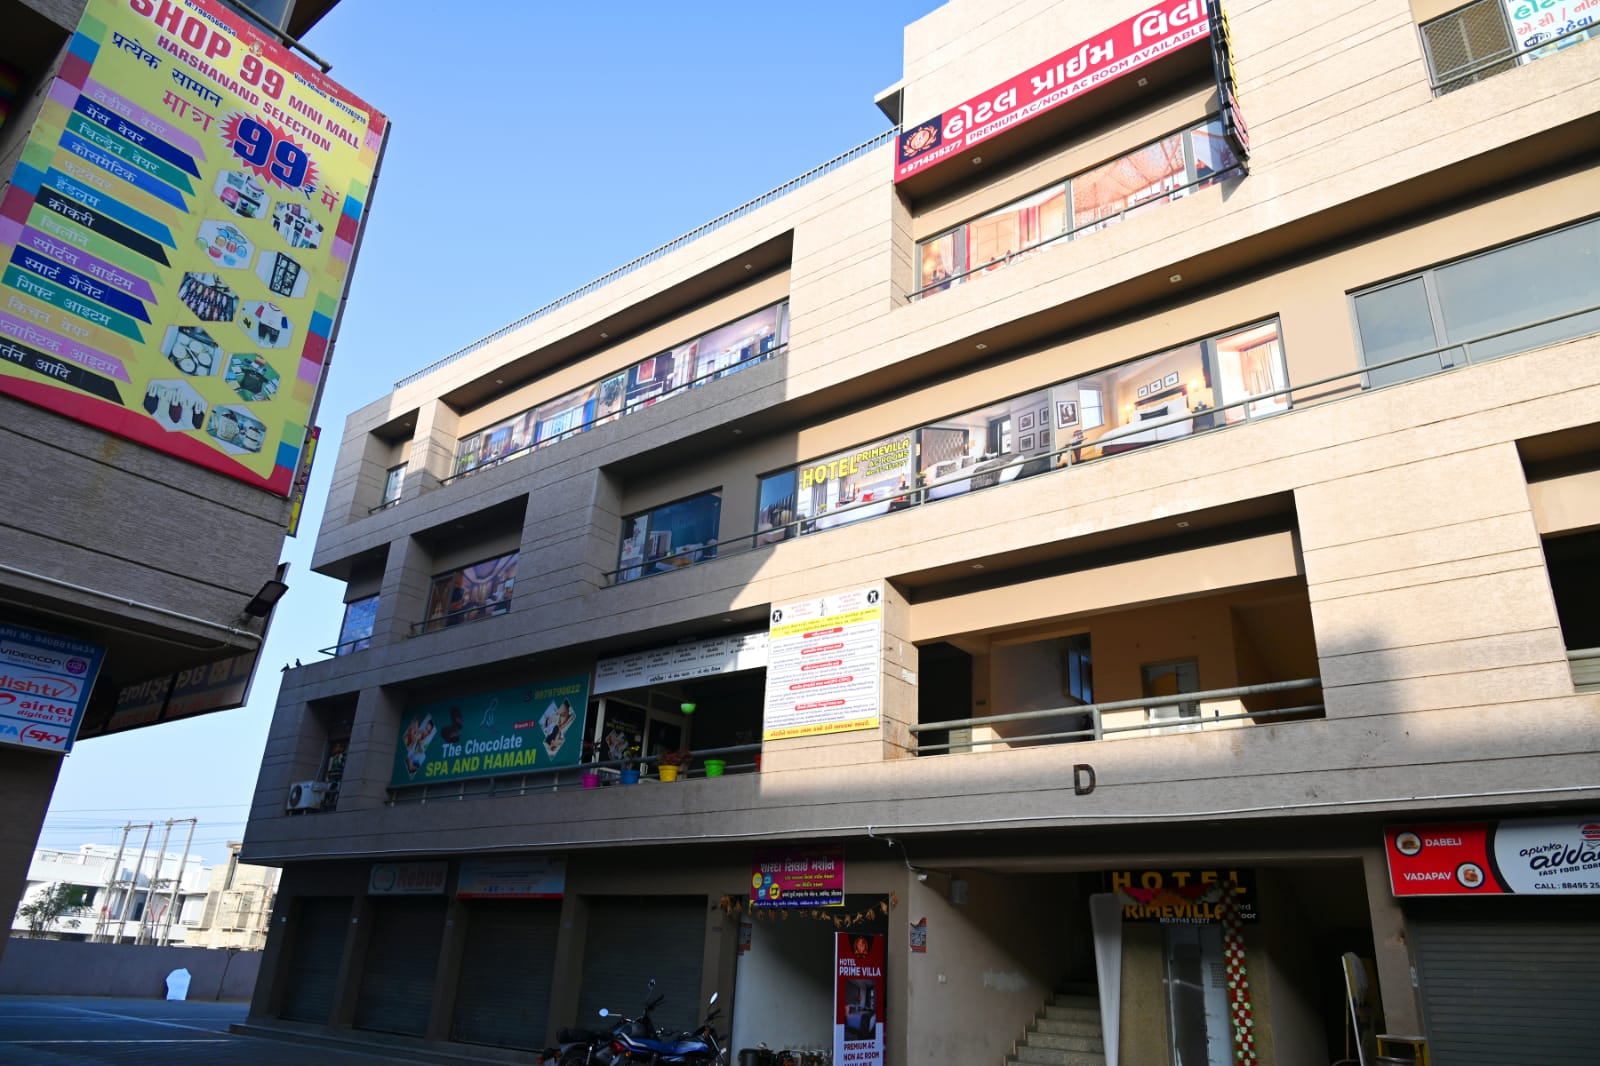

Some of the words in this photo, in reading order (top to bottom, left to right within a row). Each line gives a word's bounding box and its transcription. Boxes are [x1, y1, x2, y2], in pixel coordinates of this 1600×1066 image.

[112, 30, 162, 70] प्रत्येक
[172, 67, 223, 108] सामान
[130, 0, 232, 59] SHOP
[240, 54, 285, 100] 99
[288, 95, 323, 125] MINI
[325, 119, 359, 149] MALL
[969, 112, 1018, 141] PREMIUM
[1021, 88, 1068, 117] AC/NON
[1072, 79, 1088, 92] AC
[1092, 60, 1129, 81] ROOM
[1132, 22, 1207, 64] AVAILABLE
[157, 35, 260, 106] HARSHANAND
[262, 101, 331, 151] SELECTION
[233, 117, 309, 188] 99
[801, 454, 859, 490] HOTEL
[856, 437, 911, 464] PRIMEVILLA
[19, 700, 74, 717] airtel
[425, 760, 449, 778] SPA
[452, 756, 480, 773] AND
[483, 748, 537, 771] HAMAM
[441, 742, 462, 759] The
[464, 734, 523, 756] Chocolate
[1073, 763, 1097, 796] D
[1403, 871, 1452, 882] VADAPAV
[1539, 869, 1558, 877] FAST
[1559, 865, 1580, 874] FOOD
[839, 966, 861, 977] PRIME
[862, 967, 882, 977] VILLA
